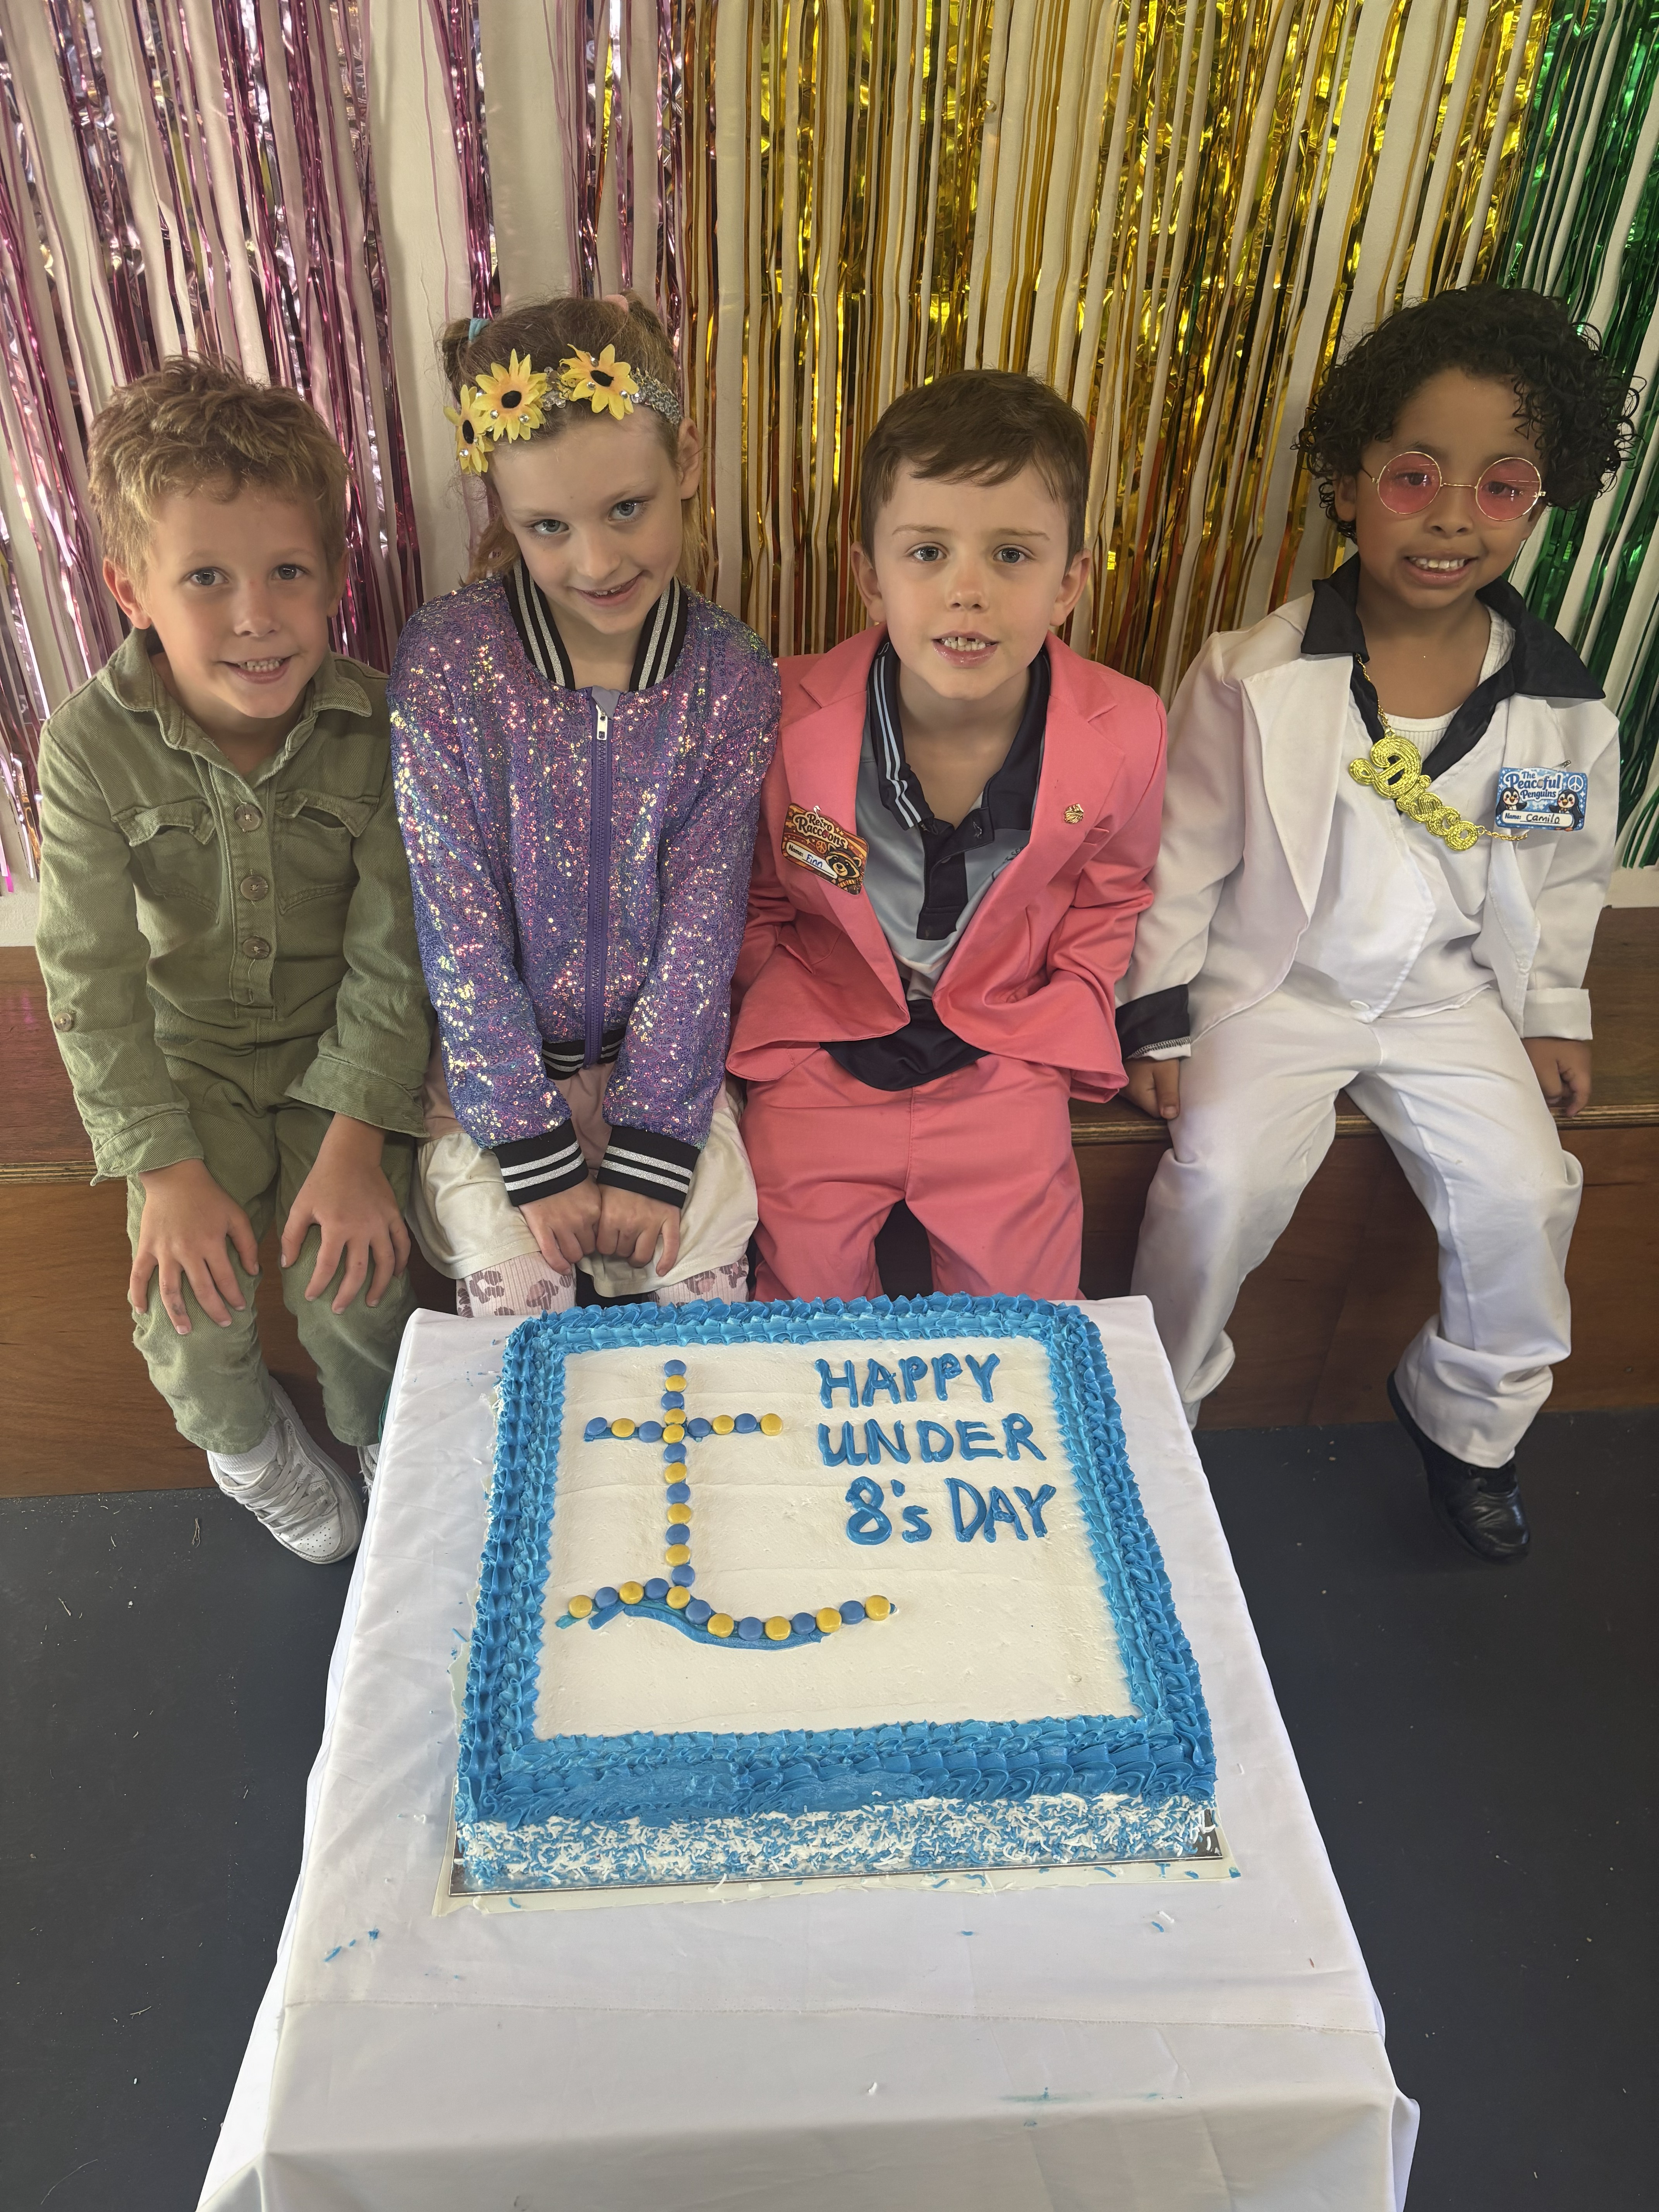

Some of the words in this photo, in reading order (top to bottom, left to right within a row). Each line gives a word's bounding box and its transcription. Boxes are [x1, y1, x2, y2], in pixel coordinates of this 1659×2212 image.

[1349, 735, 1478, 851] Disco
[1520, 789, 1556, 799] Penguins
[807, 814, 832, 831] Retro
[1526, 814, 1560, 824] Camilo
[789, 844, 804, 857] Name:
[806, 854, 823, 868] Finn
[815, 1353, 1000, 1408] HAPPY
[817, 1413, 1047, 1467] UNDER
[845, 1476, 932, 1545] 8's
[944, 1477, 1057, 1543] DAY
